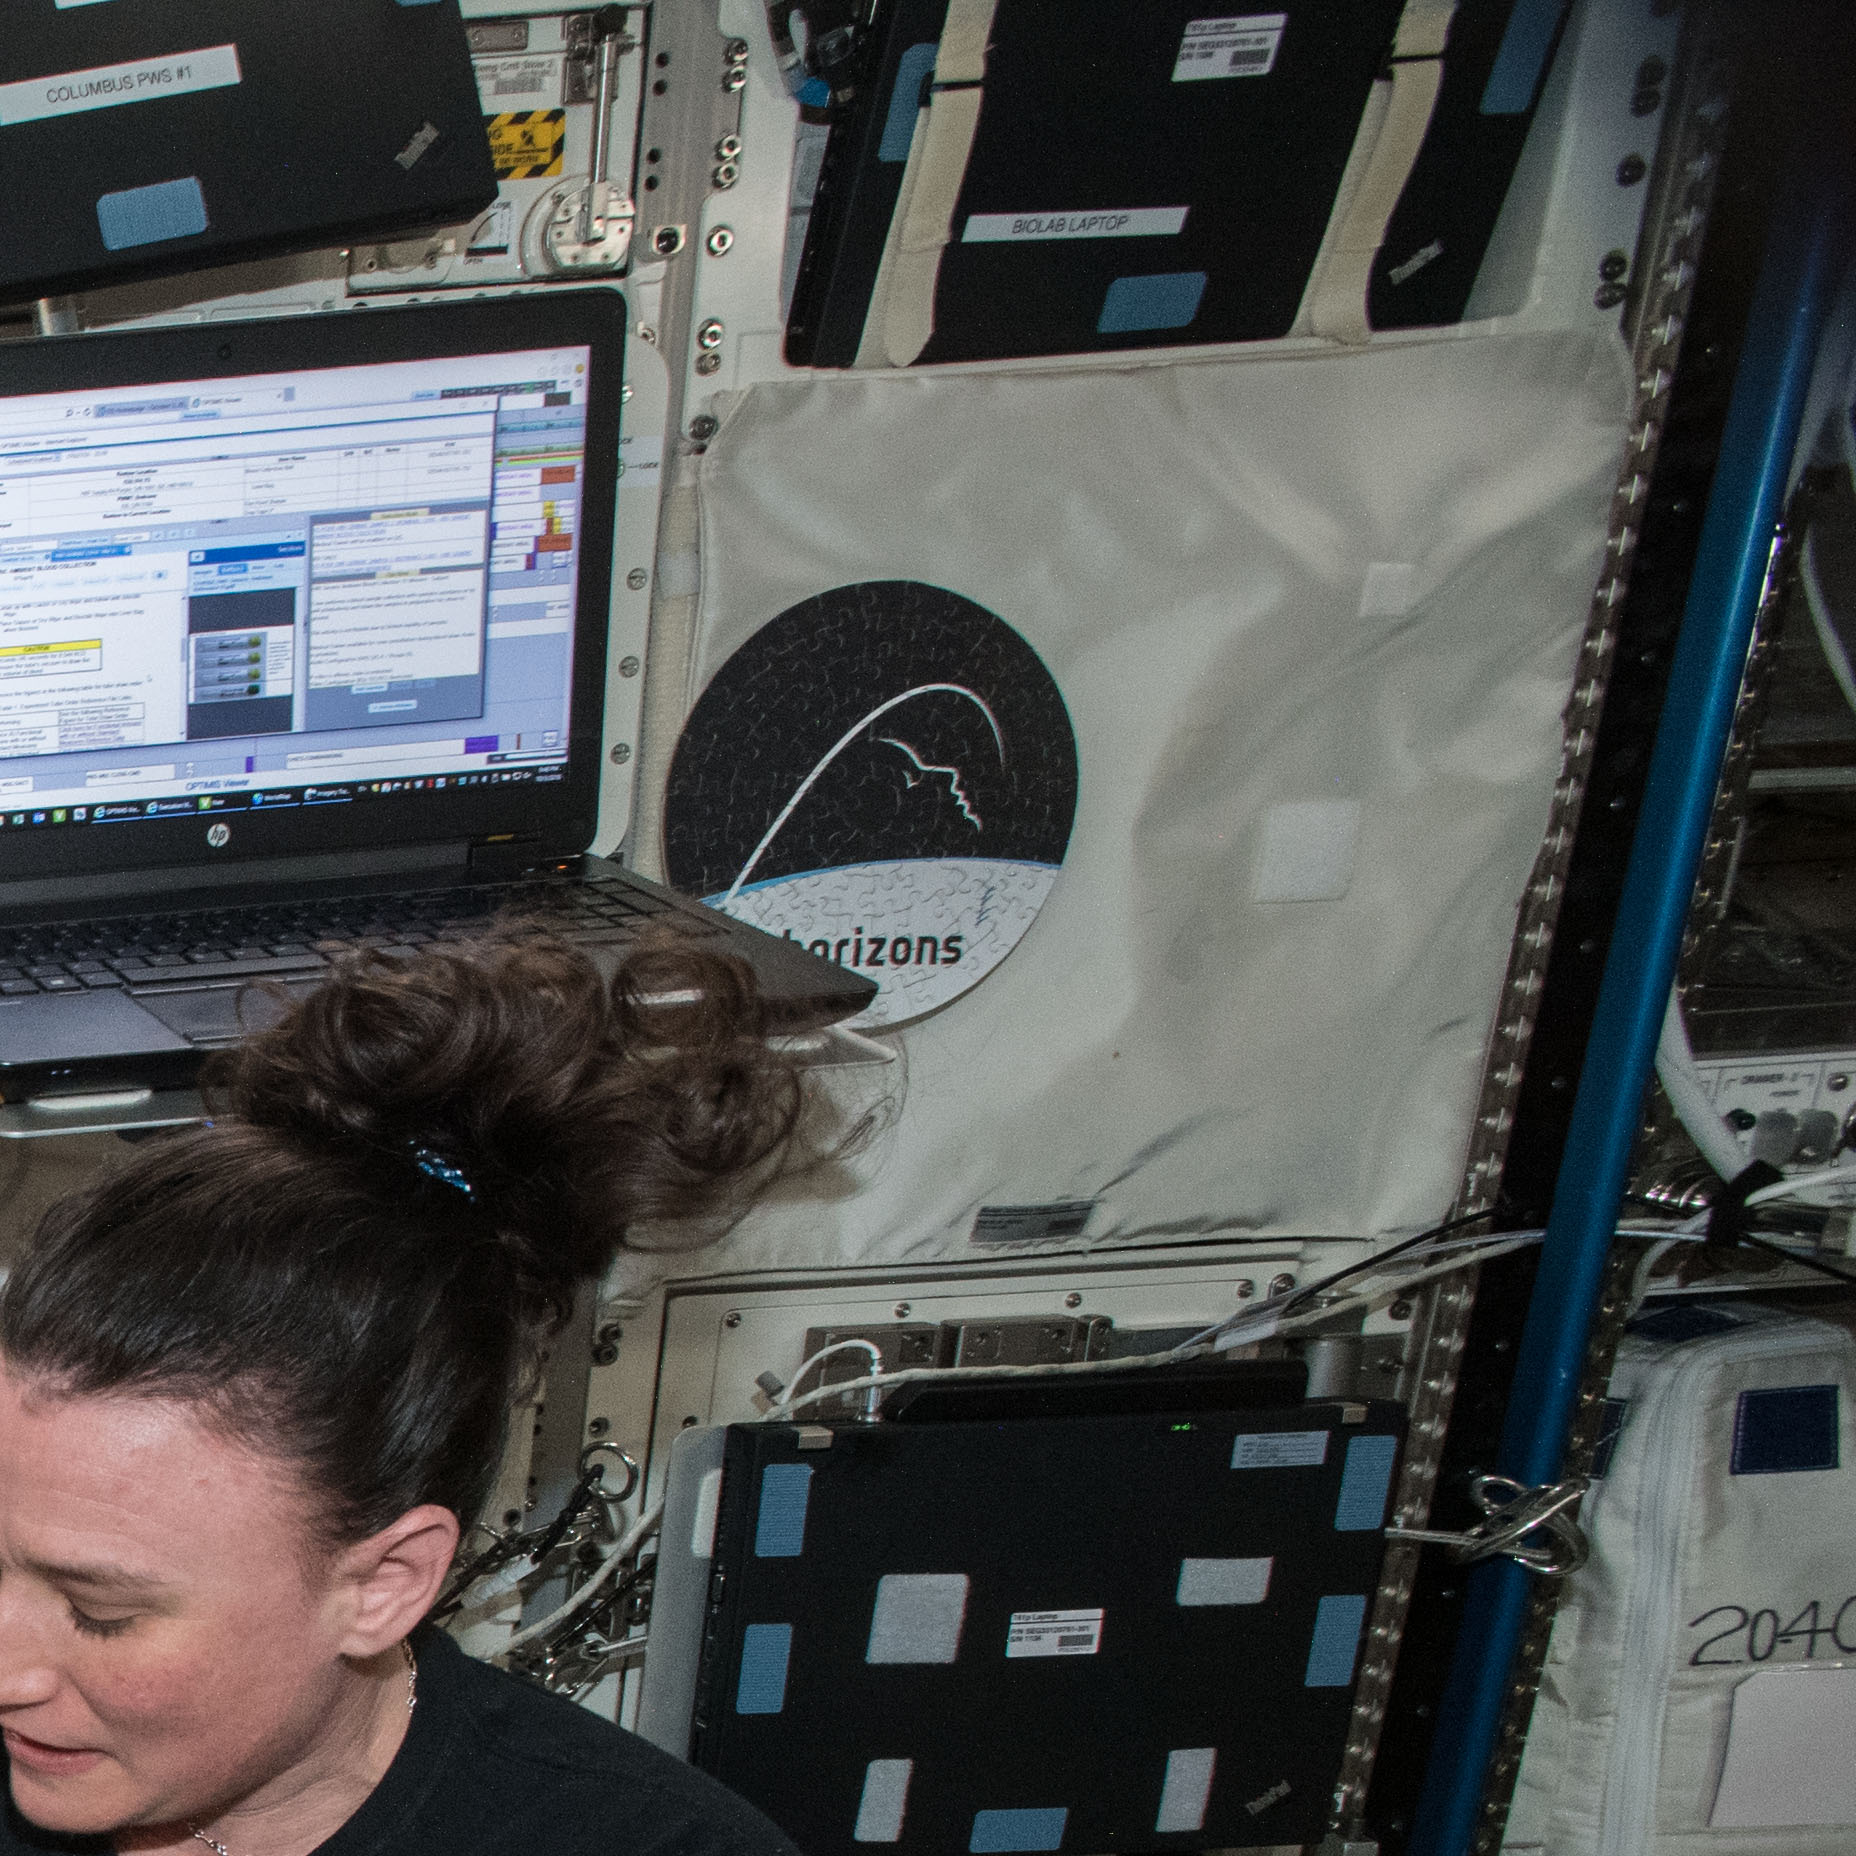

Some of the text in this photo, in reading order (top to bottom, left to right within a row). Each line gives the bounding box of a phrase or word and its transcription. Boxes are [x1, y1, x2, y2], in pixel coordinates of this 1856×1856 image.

[46, 65, 193, 104] COLUMBUS PWS #1
[1012, 215, 1129, 234] BIOLAB LAPTOP
[220, 778, 250, 789] Viewer
[210, 826, 228, 844] hp
